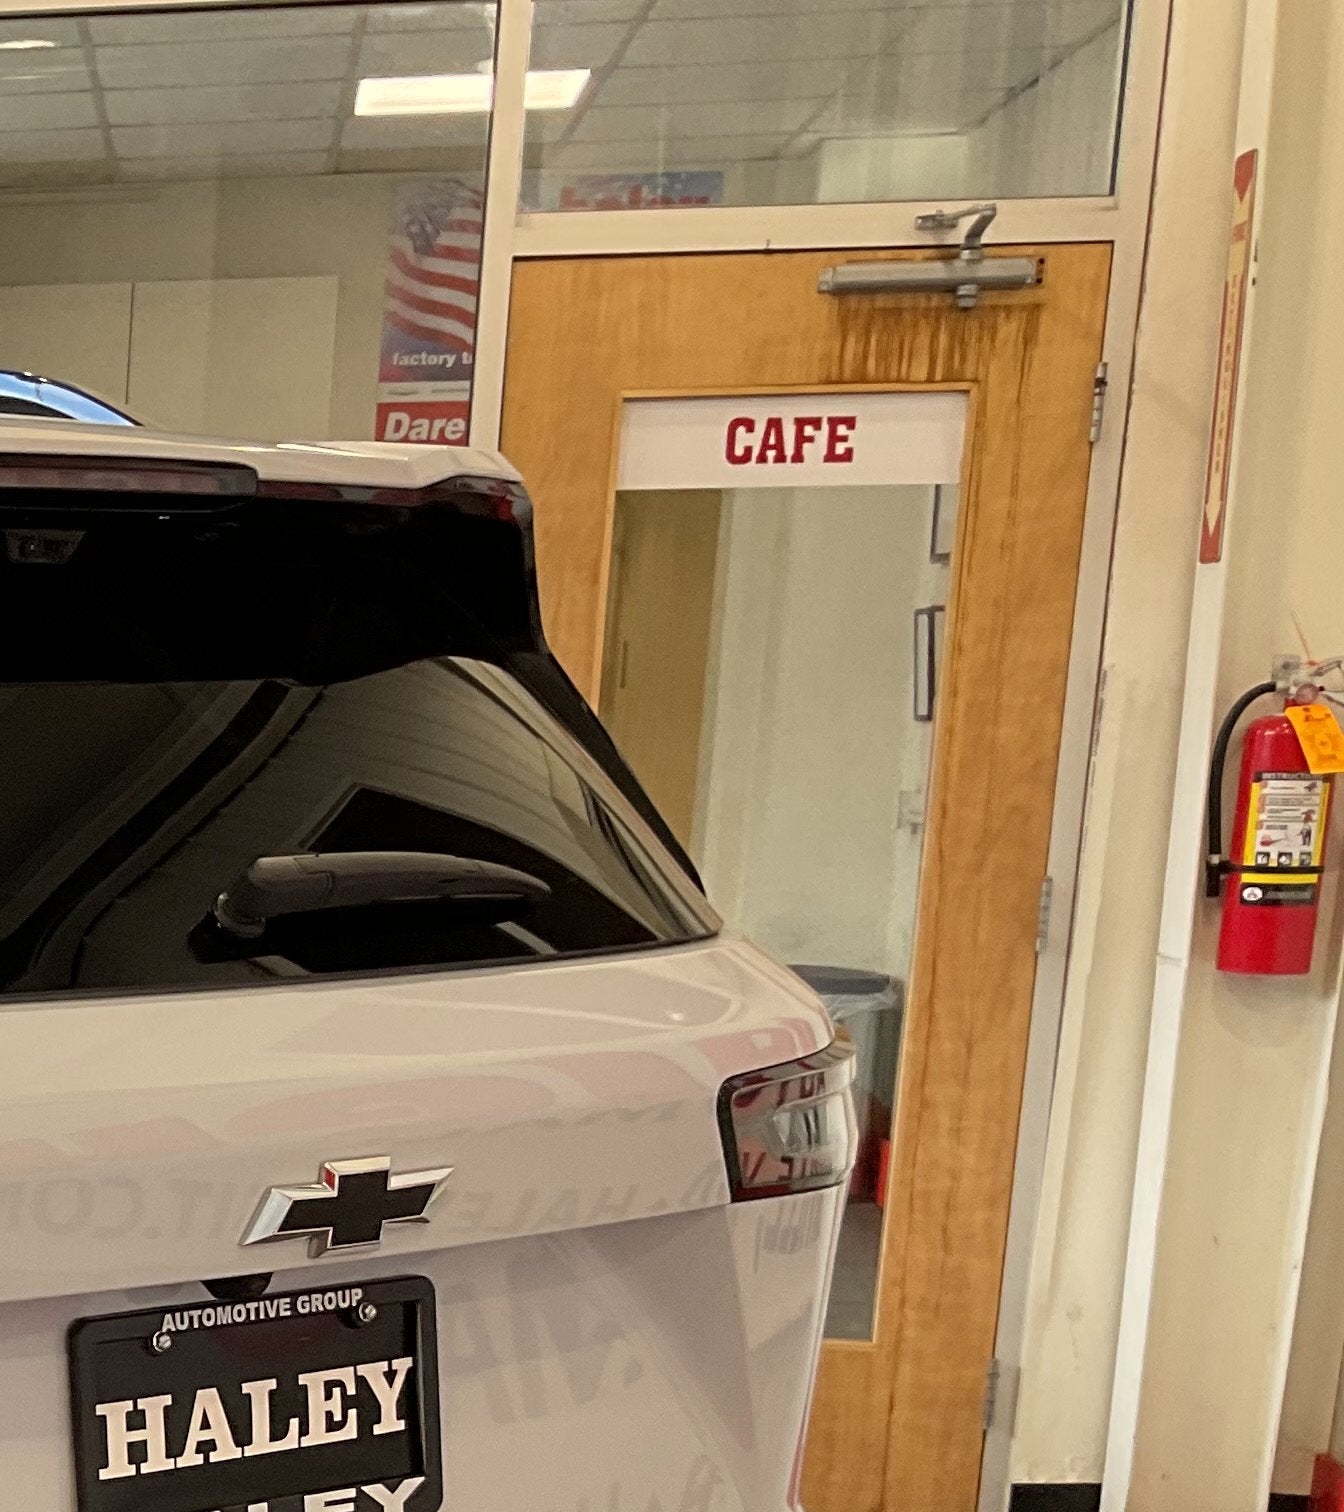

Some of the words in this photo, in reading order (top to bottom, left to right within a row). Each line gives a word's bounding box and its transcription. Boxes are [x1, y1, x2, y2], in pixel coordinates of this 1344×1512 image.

[393, 350, 456, 368] factory
[383, 411, 466, 441] Dare
[725, 416, 857, 465] CAFE
[161, 1298, 291, 1333] AUTOMOTIVE
[296, 1287, 363, 1314] GROUP
[95, 1356, 413, 1481] HALEY
